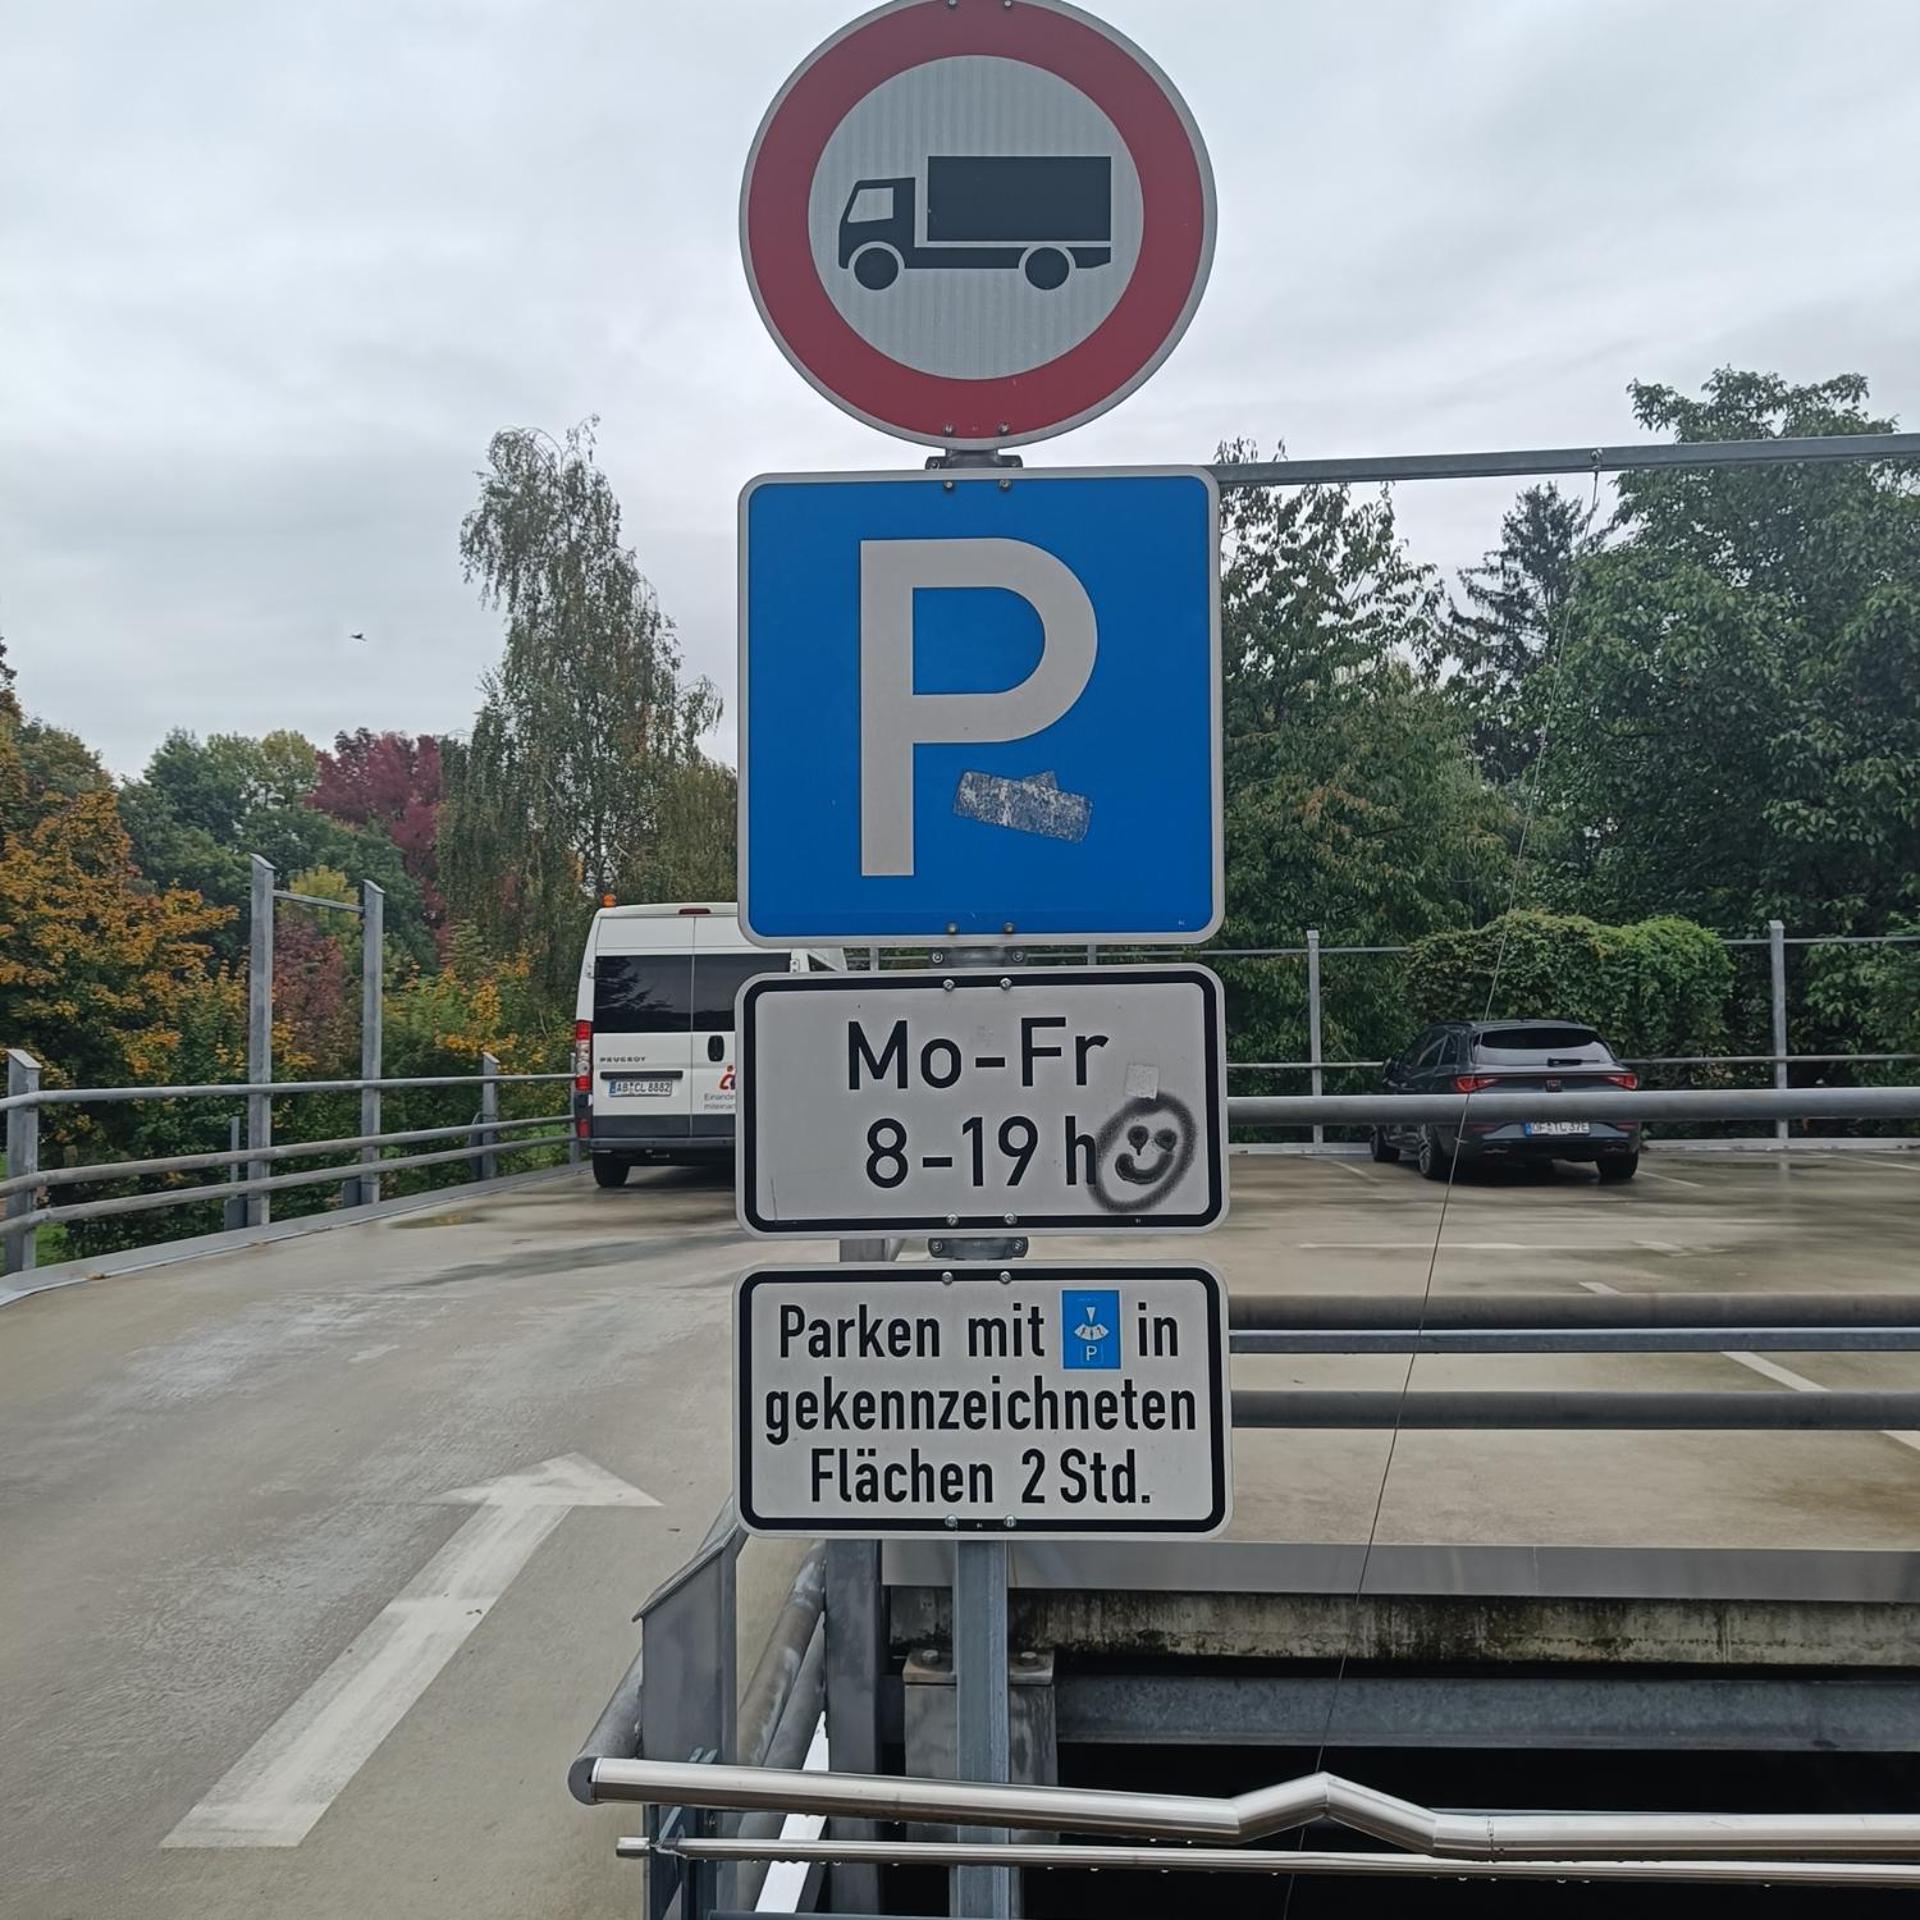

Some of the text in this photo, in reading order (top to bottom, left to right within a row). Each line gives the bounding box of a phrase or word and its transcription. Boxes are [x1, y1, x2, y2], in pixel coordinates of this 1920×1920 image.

[861, 538, 1098, 877] P
[599, 1055, 646, 1063] PEUGEOT
[849, 1017, 1109, 1091] Mo-Fr
[866, 1116, 1097, 1189] 8-19 h
[779, 1302, 1179, 1358] Parken mit in
[765, 1375, 1196, 1446] gekennzeichneten
[811, 1448, 1151, 1504] Flächen 2 Std.
